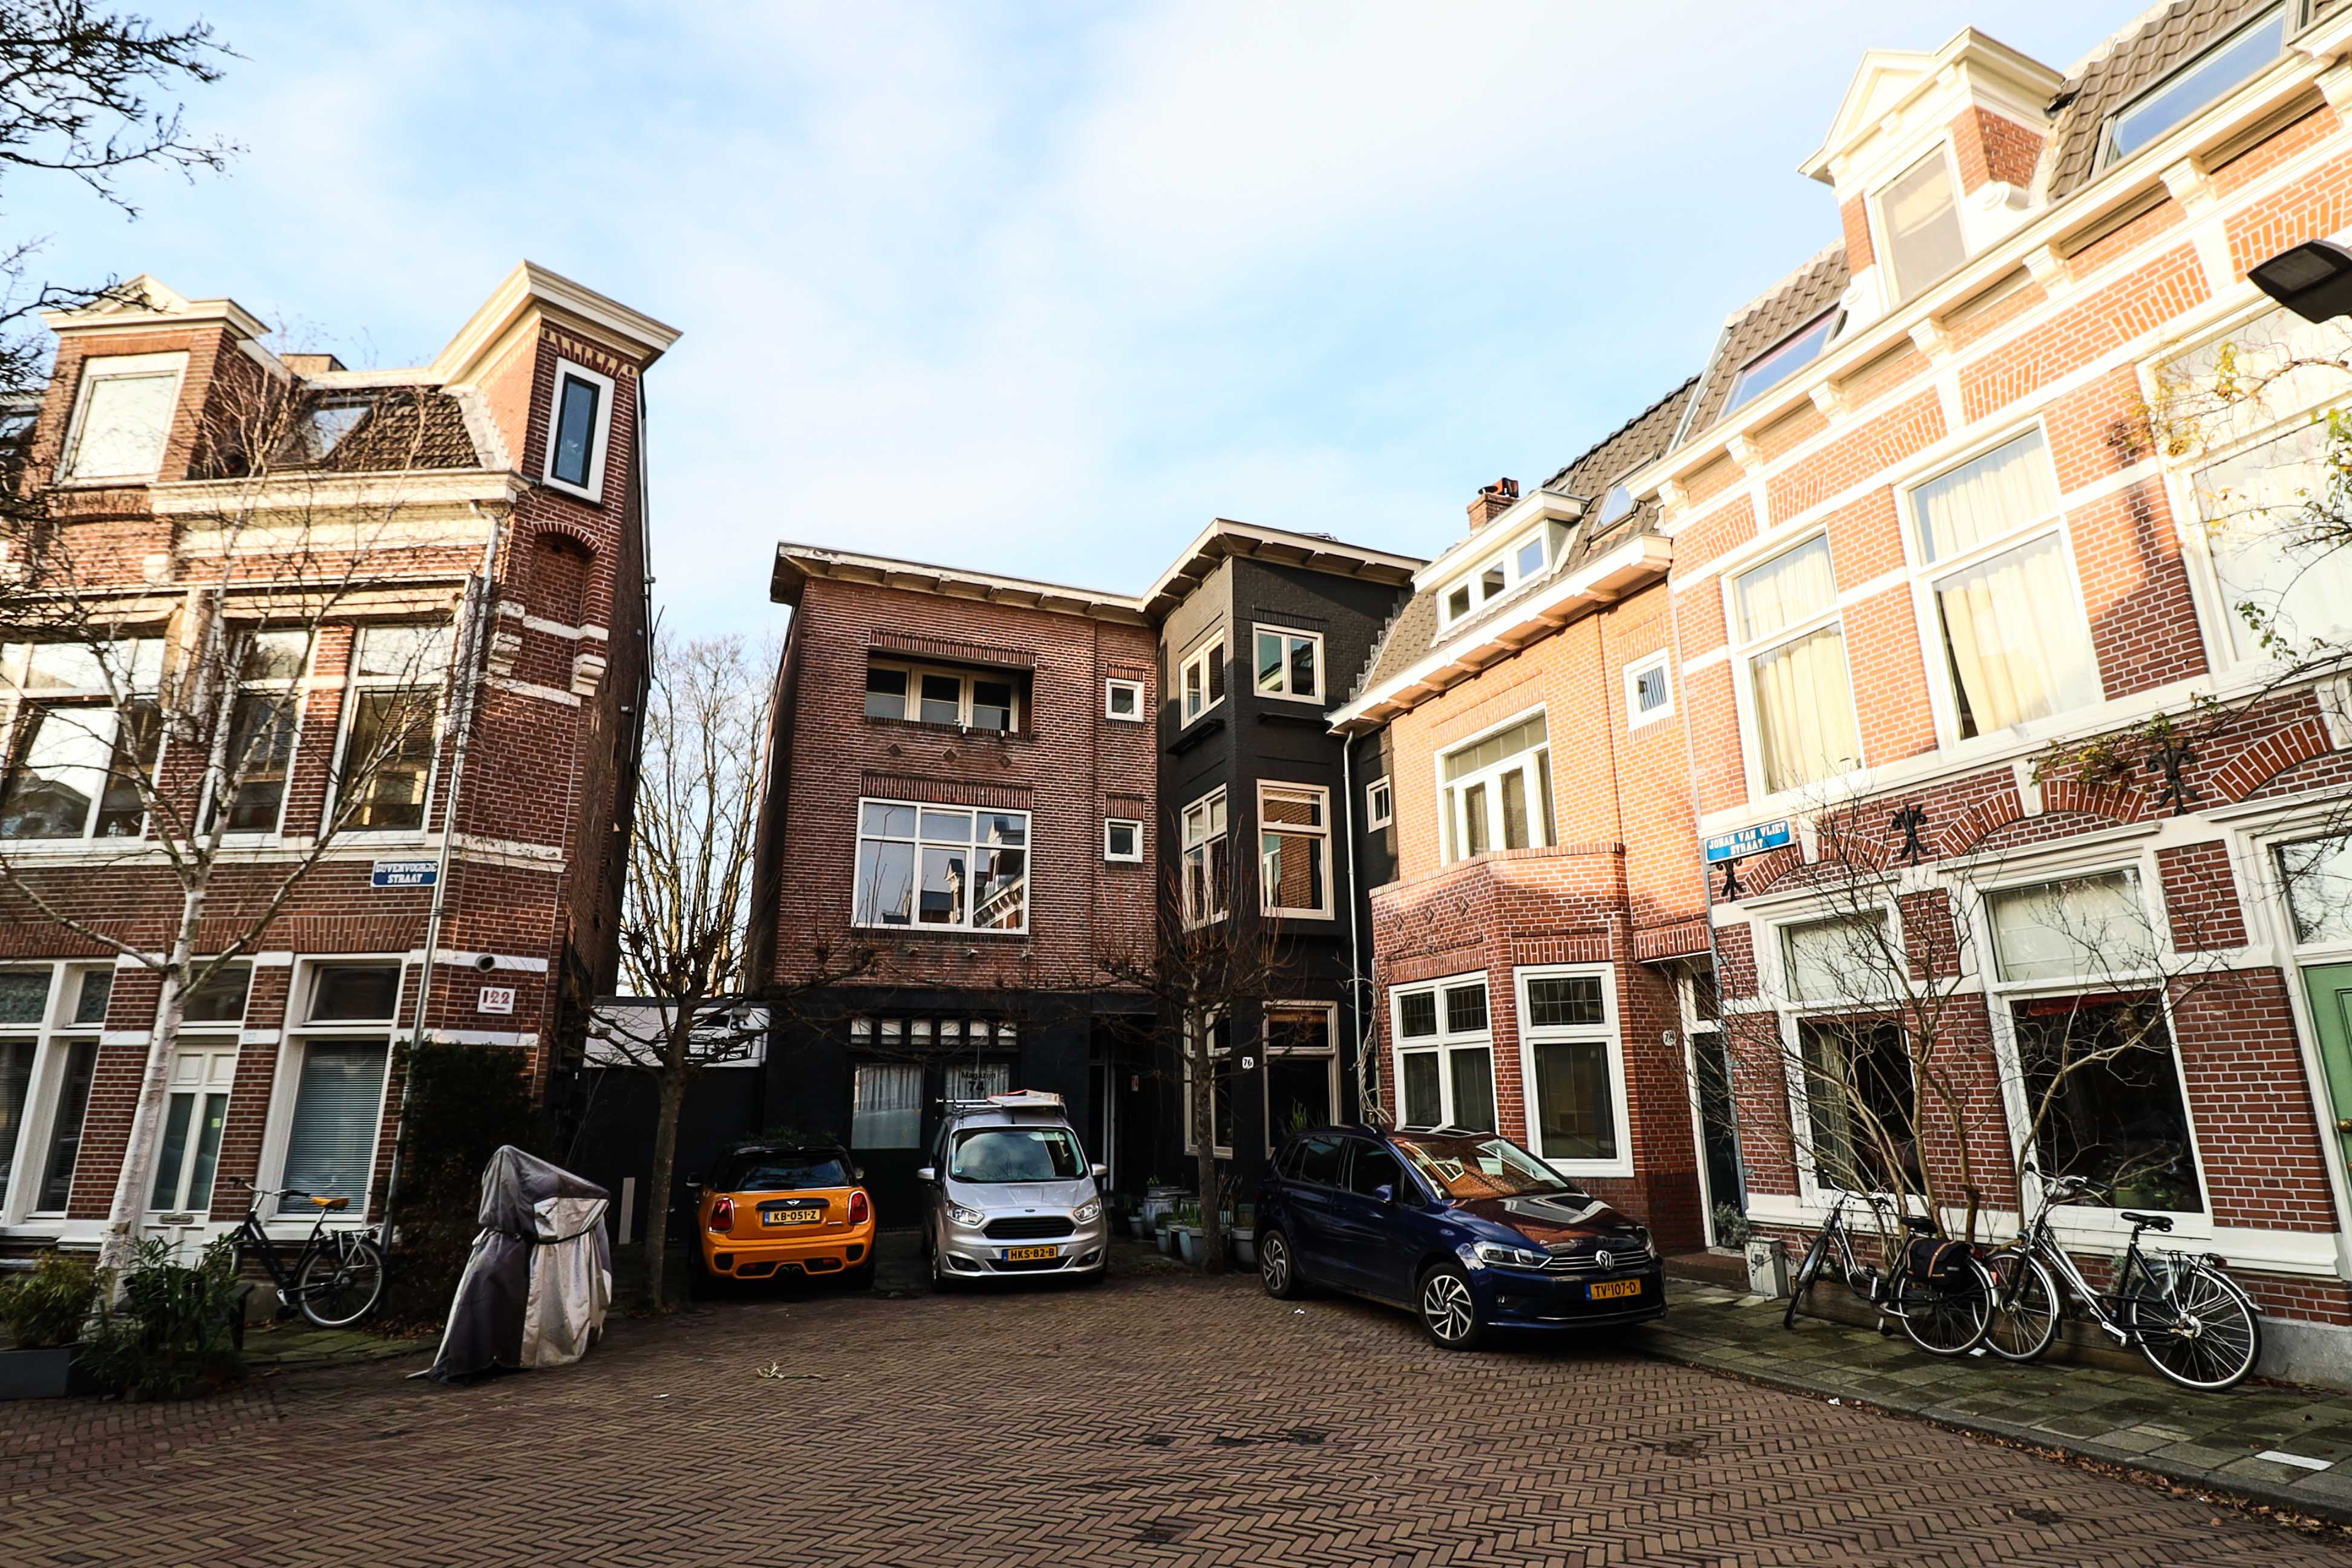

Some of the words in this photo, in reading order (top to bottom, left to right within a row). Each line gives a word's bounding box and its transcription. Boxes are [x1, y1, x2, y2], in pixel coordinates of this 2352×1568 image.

[1709, 835, 1736, 849] JOHAN
[1738, 829, 1756, 841] VAN
[1759, 822, 1786, 837] VLIET
[1730, 839, 1764, 855] STRAAT
[387, 874, 423, 884] STRAAT
[483, 990, 510, 1004] 122
[1243, 1059, 1252, 1067] 76
[961, 1071, 996, 1080] Magazijn
[969, 1081, 984, 1092] 74
[774, 1210, 816, 1221] KB-051-Z
[1011, 1248, 1055, 1259] HKS-82-B
